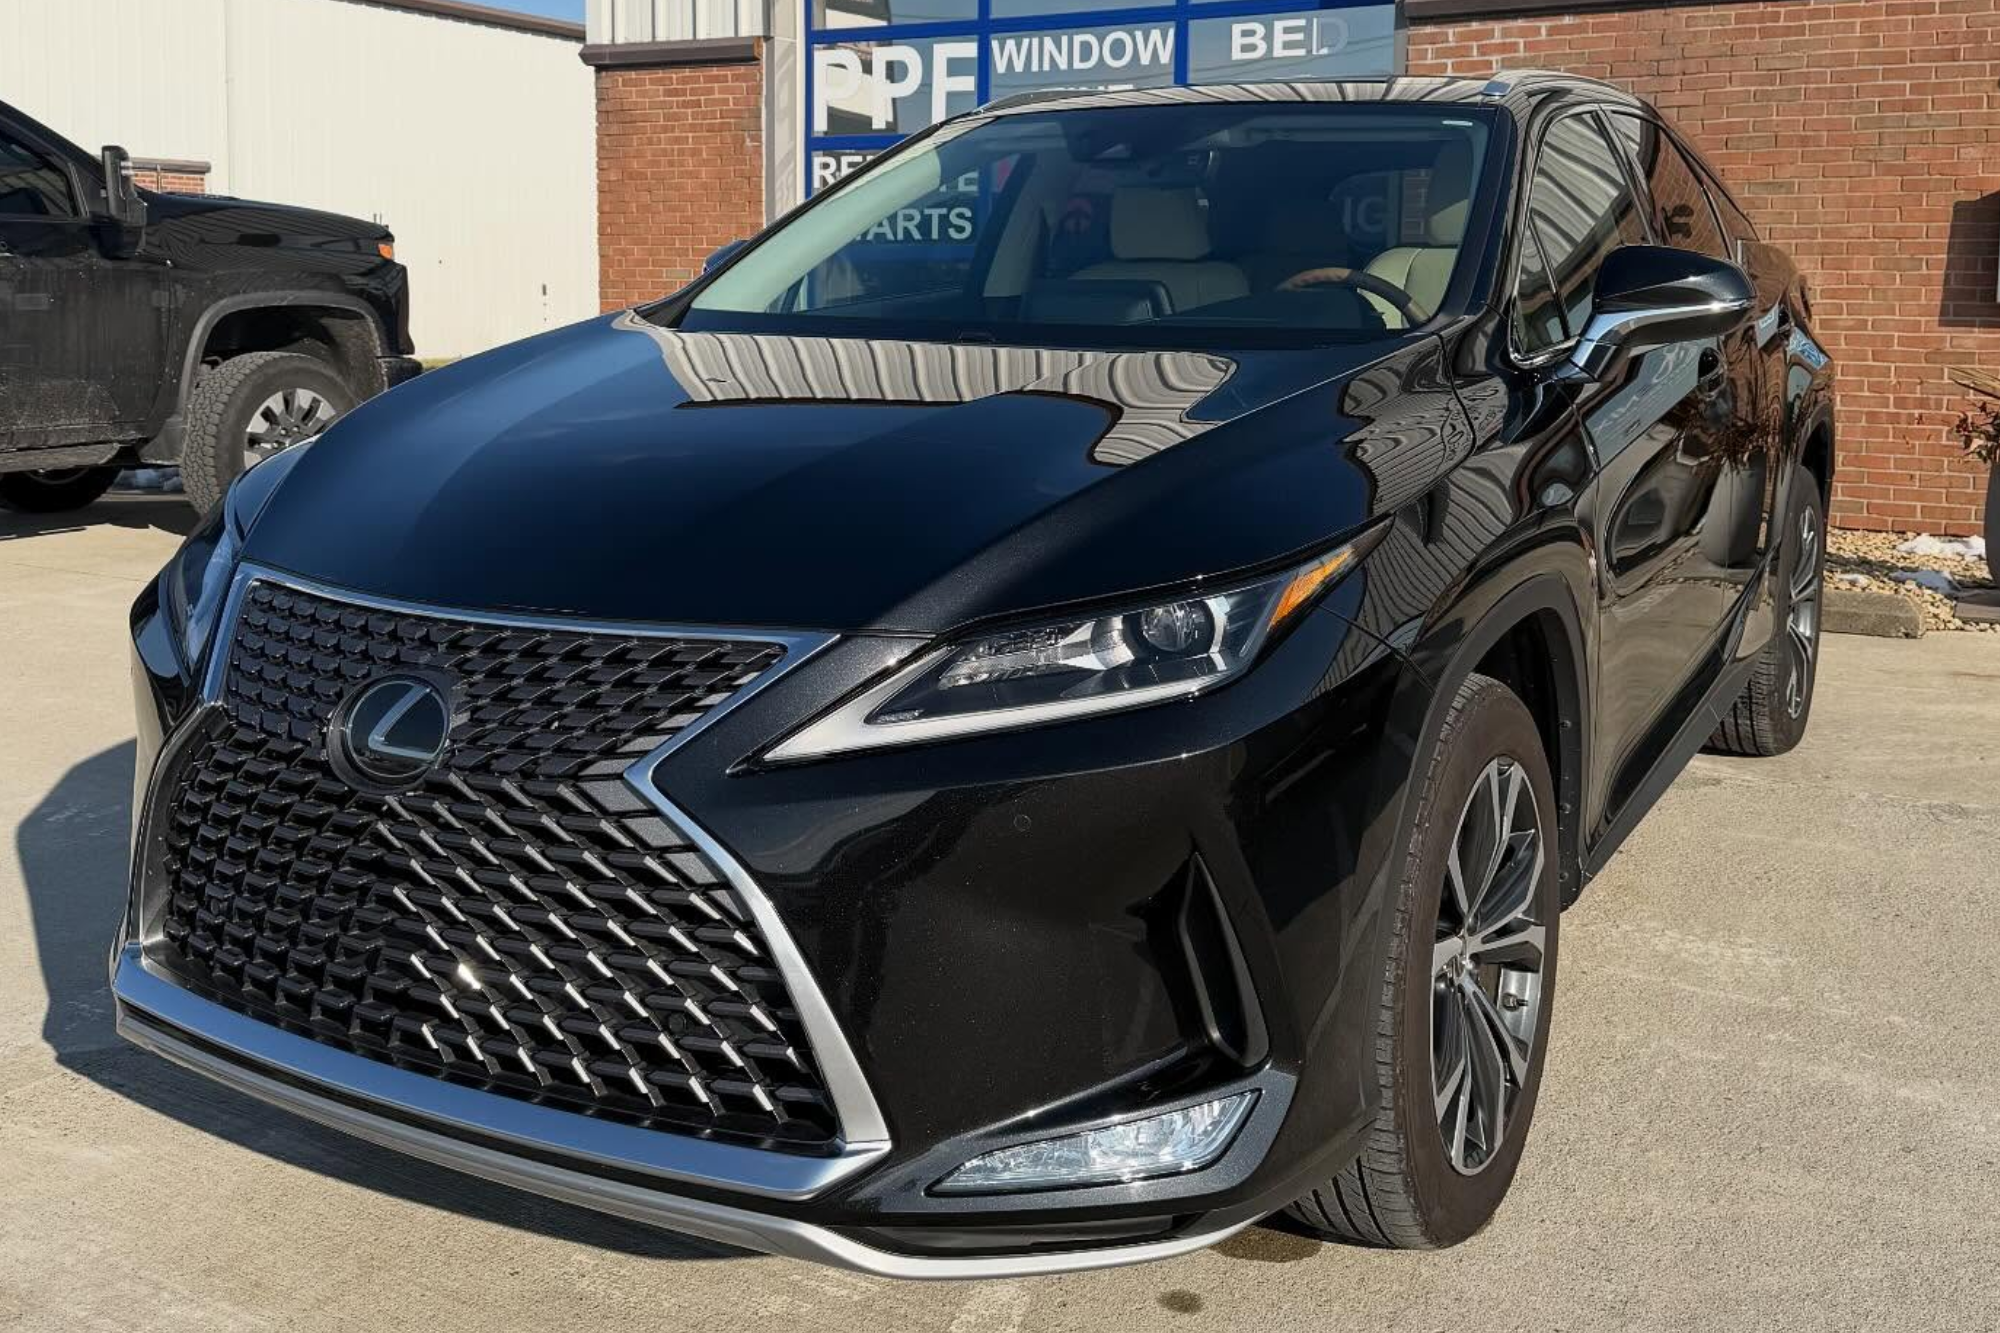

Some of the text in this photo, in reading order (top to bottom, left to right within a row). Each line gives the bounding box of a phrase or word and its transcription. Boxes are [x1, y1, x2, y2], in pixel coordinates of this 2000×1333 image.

[991, 28, 1175, 74] WINDOW
[813, 42, 978, 131] PPF
[855, 206, 973, 241] ARTS
